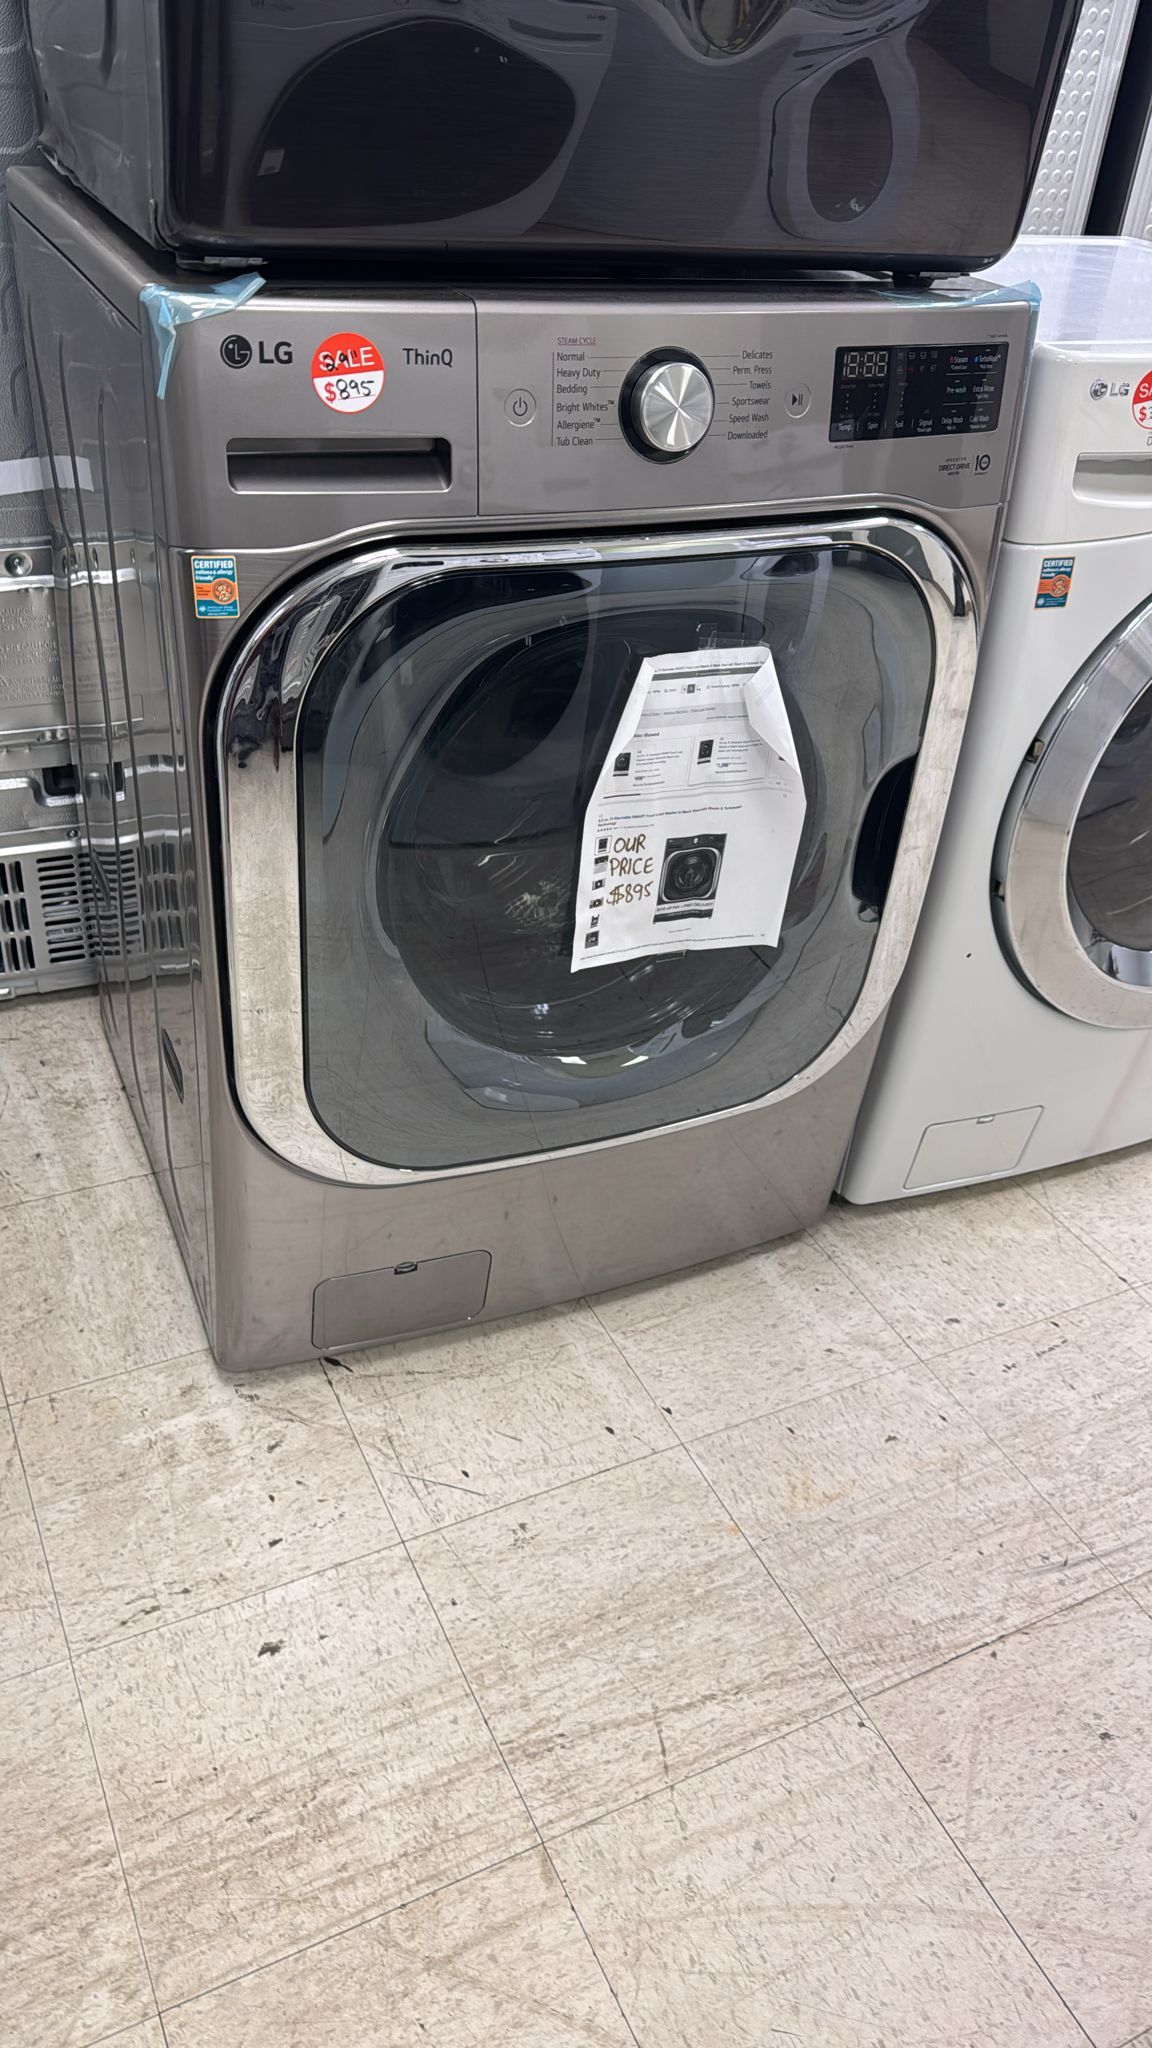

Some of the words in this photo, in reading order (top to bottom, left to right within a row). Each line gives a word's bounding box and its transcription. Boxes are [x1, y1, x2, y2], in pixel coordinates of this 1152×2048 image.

[557, 337, 578, 345] STEAM
[579, 337, 596, 345] CYCLE
[258, 341, 293, 364] LG
[402, 347, 453, 368] ThinQ
[557, 352, 585, 361] Normal
[742, 349, 773, 359] Delicates
[319, 346, 375, 371] SALE
[557, 368, 580, 379] Heavy
[582, 368, 601, 379] Duty
[733, 366, 752, 374] Perm.
[754, 365, 772, 374] Press
[557, 384, 587, 395] Bedding
[750, 380, 771, 389] Towels
[1110, 382, 1130, 396] LG
[324, 378, 375, 403] $895
[732, 397, 770, 407] Sportswear
[557, 403, 580, 414] Bright
[729, 413, 750, 424] Speed
[752, 413, 769, 421] Wash
[919, 418, 933, 427] Signal
[941, 417, 952, 425] Delay
[895, 420, 904, 428] Soil
[728, 430, 768, 440] Downloaded
[557, 437, 570, 446] Tub
[572, 436, 593, 445] Clean
[938, 463, 955, 471] DIRECT
[956, 462, 971, 470] DRIVE
[194, 560, 233, 569] CERTIFIED
[1043, 559, 1073, 567] CERTIFIED
[613, 833, 646, 854] OUR
[609, 857, 654, 877] PRICE
[606, 881, 653, 906] $895
